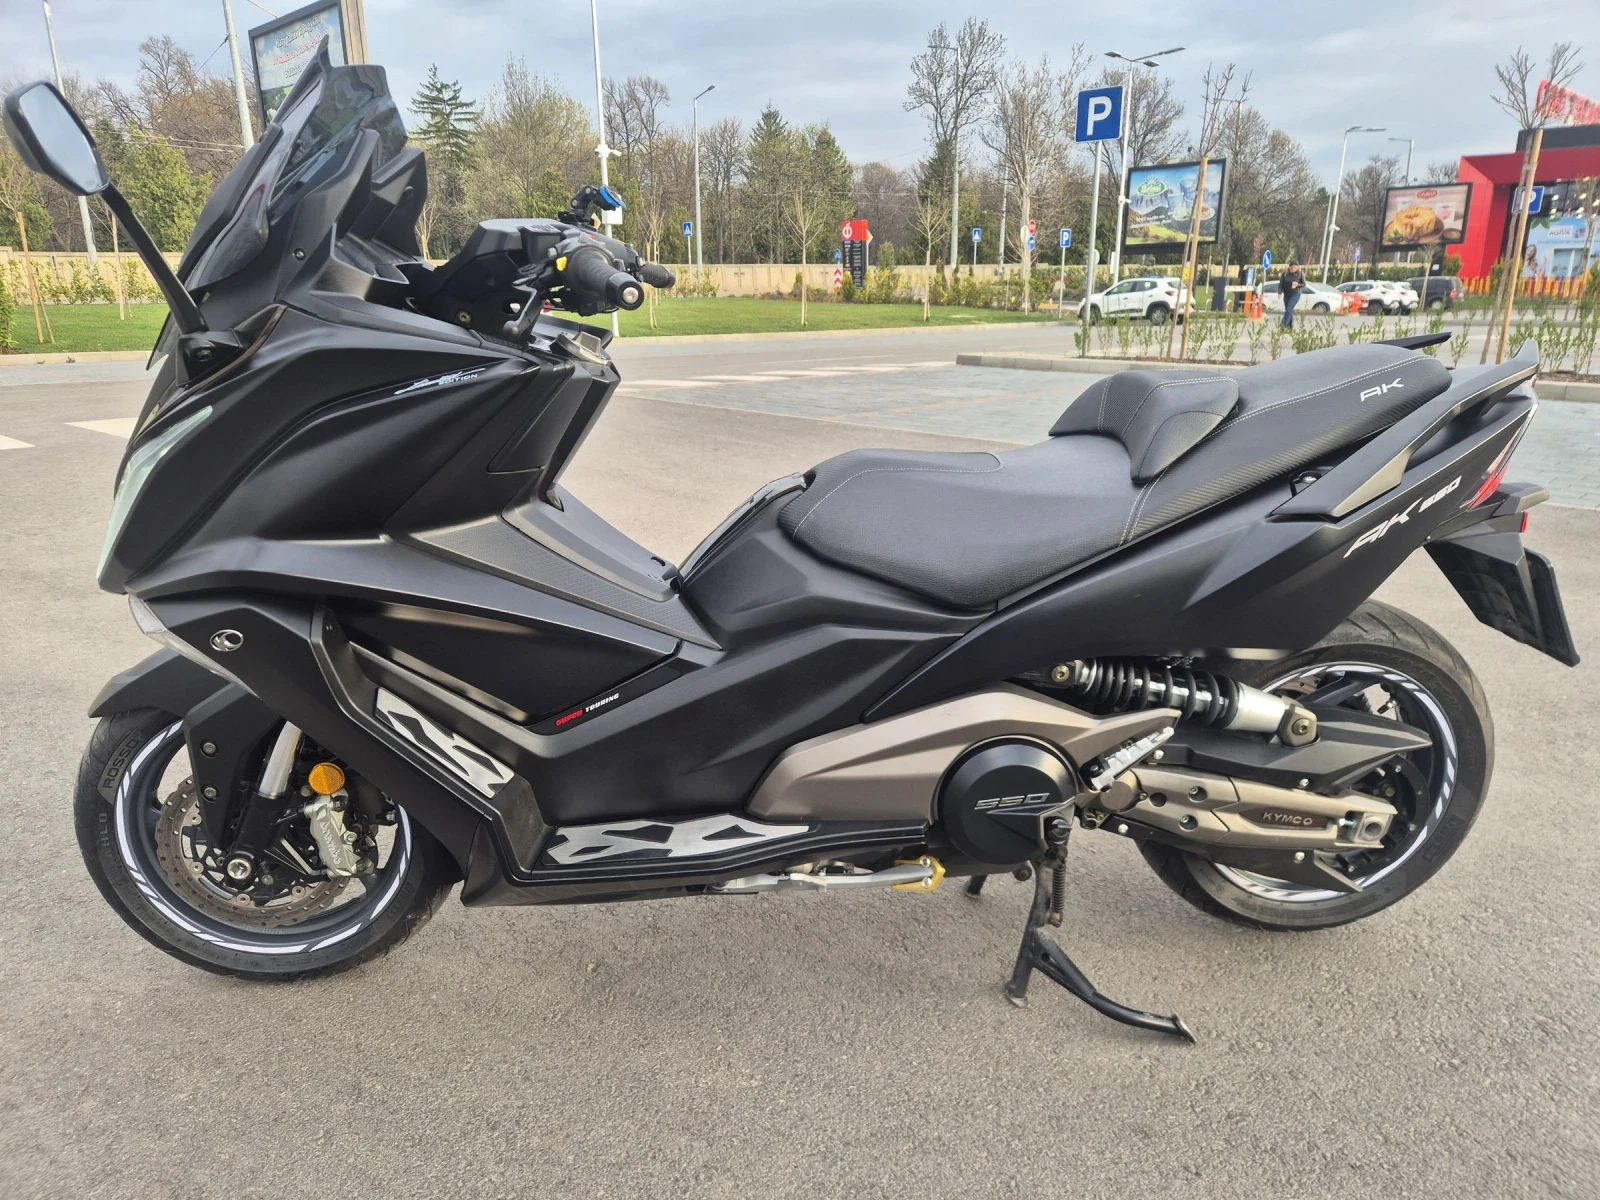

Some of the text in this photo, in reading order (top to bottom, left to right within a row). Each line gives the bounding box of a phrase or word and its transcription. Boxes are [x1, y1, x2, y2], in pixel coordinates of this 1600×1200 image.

[1087, 96, 1112, 136] P
[1360, 378, 1404, 402] AK
[1343, 497, 1423, 558] AK
[585, 693, 619, 712] TOURING
[103, 737, 139, 790] ROSSO
[974, 792, 1050, 810] 550
[1263, 811, 1313, 826] KYMCO
